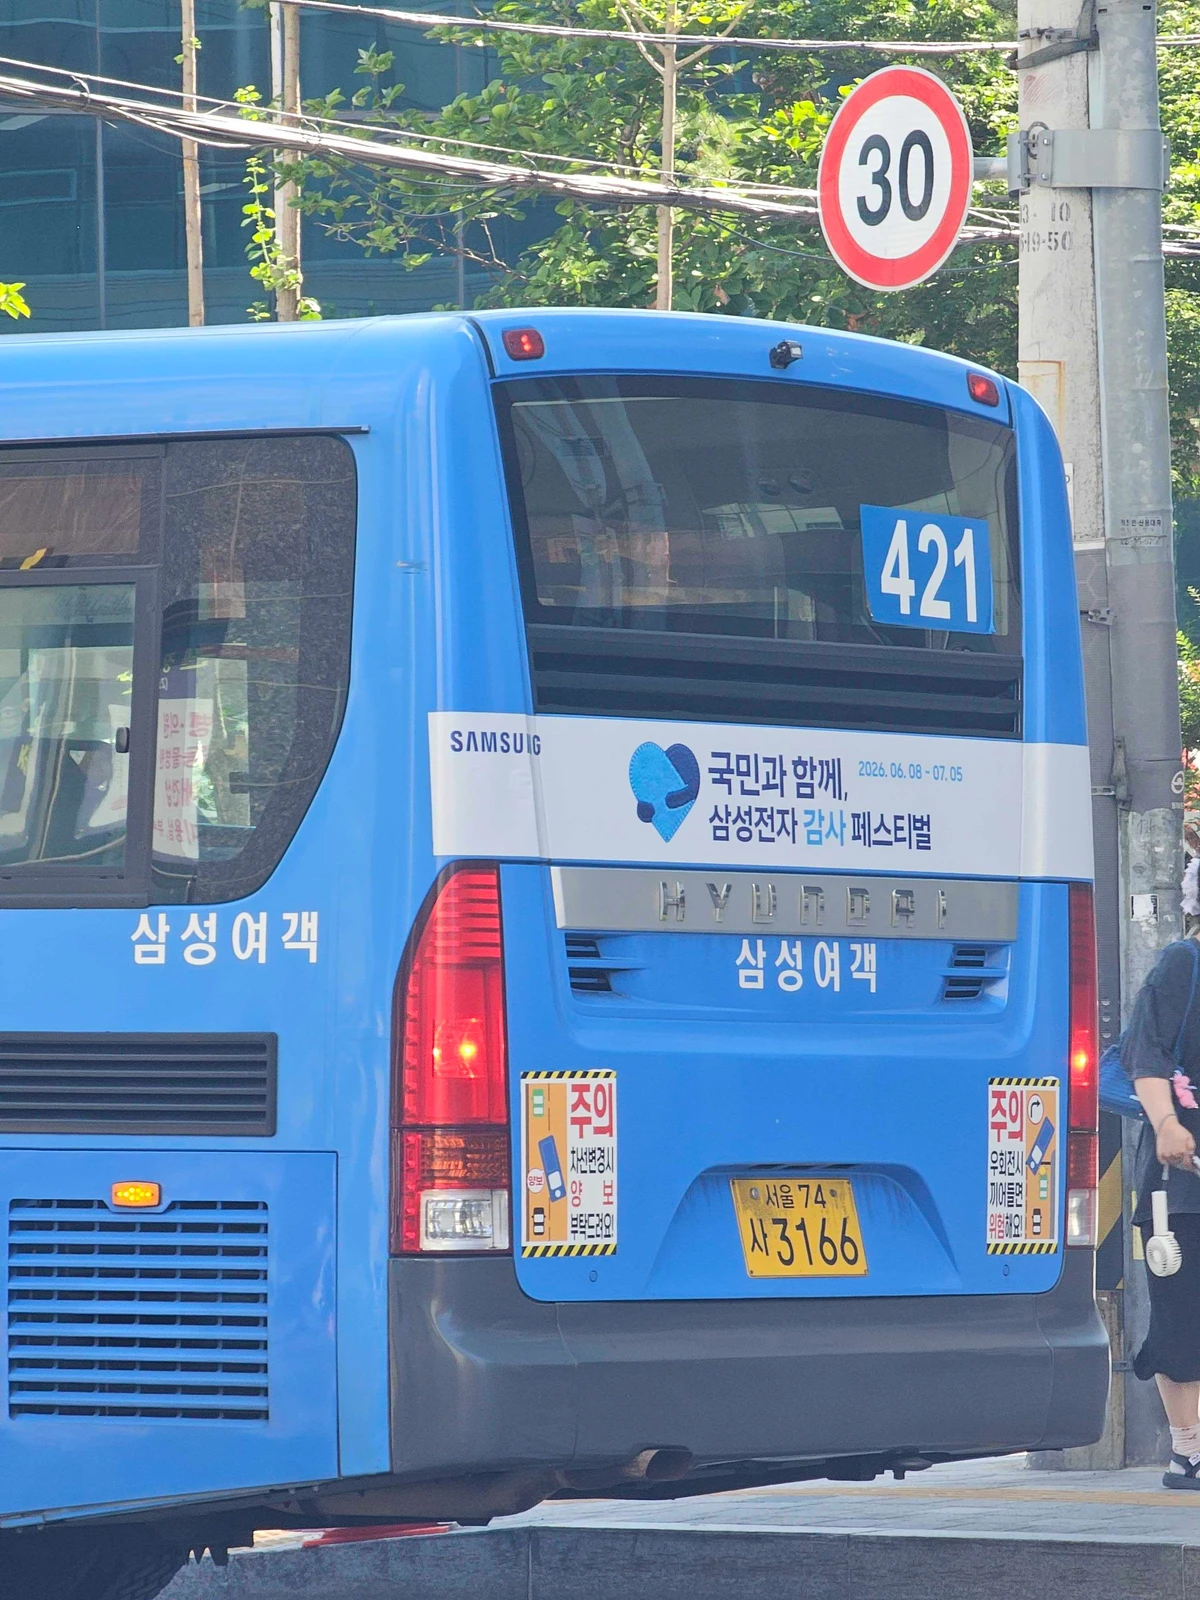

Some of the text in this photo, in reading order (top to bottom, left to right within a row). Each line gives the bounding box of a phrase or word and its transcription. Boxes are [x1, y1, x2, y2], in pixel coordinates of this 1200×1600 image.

[856, 129, 935, 227] 30
[881, 519, 977, 623] 421
[708, 751, 848, 801] 국민과 함께,
[708, 804, 931, 851] 삼성전자 감사 페스티벌
[659, 880, 947, 929] HYUNDAI
[130, 911, 319, 966] 삼성여객
[735, 938, 877, 993] 삼성여객
[570, 1083, 614, 1139] 주의
[991, 1090, 1024, 1142] 주의
[570, 1146, 614, 1175] 차선변경시
[990, 1150, 1024, 1177] 우회전시
[989, 1182, 1023, 1208] 끼어들면
